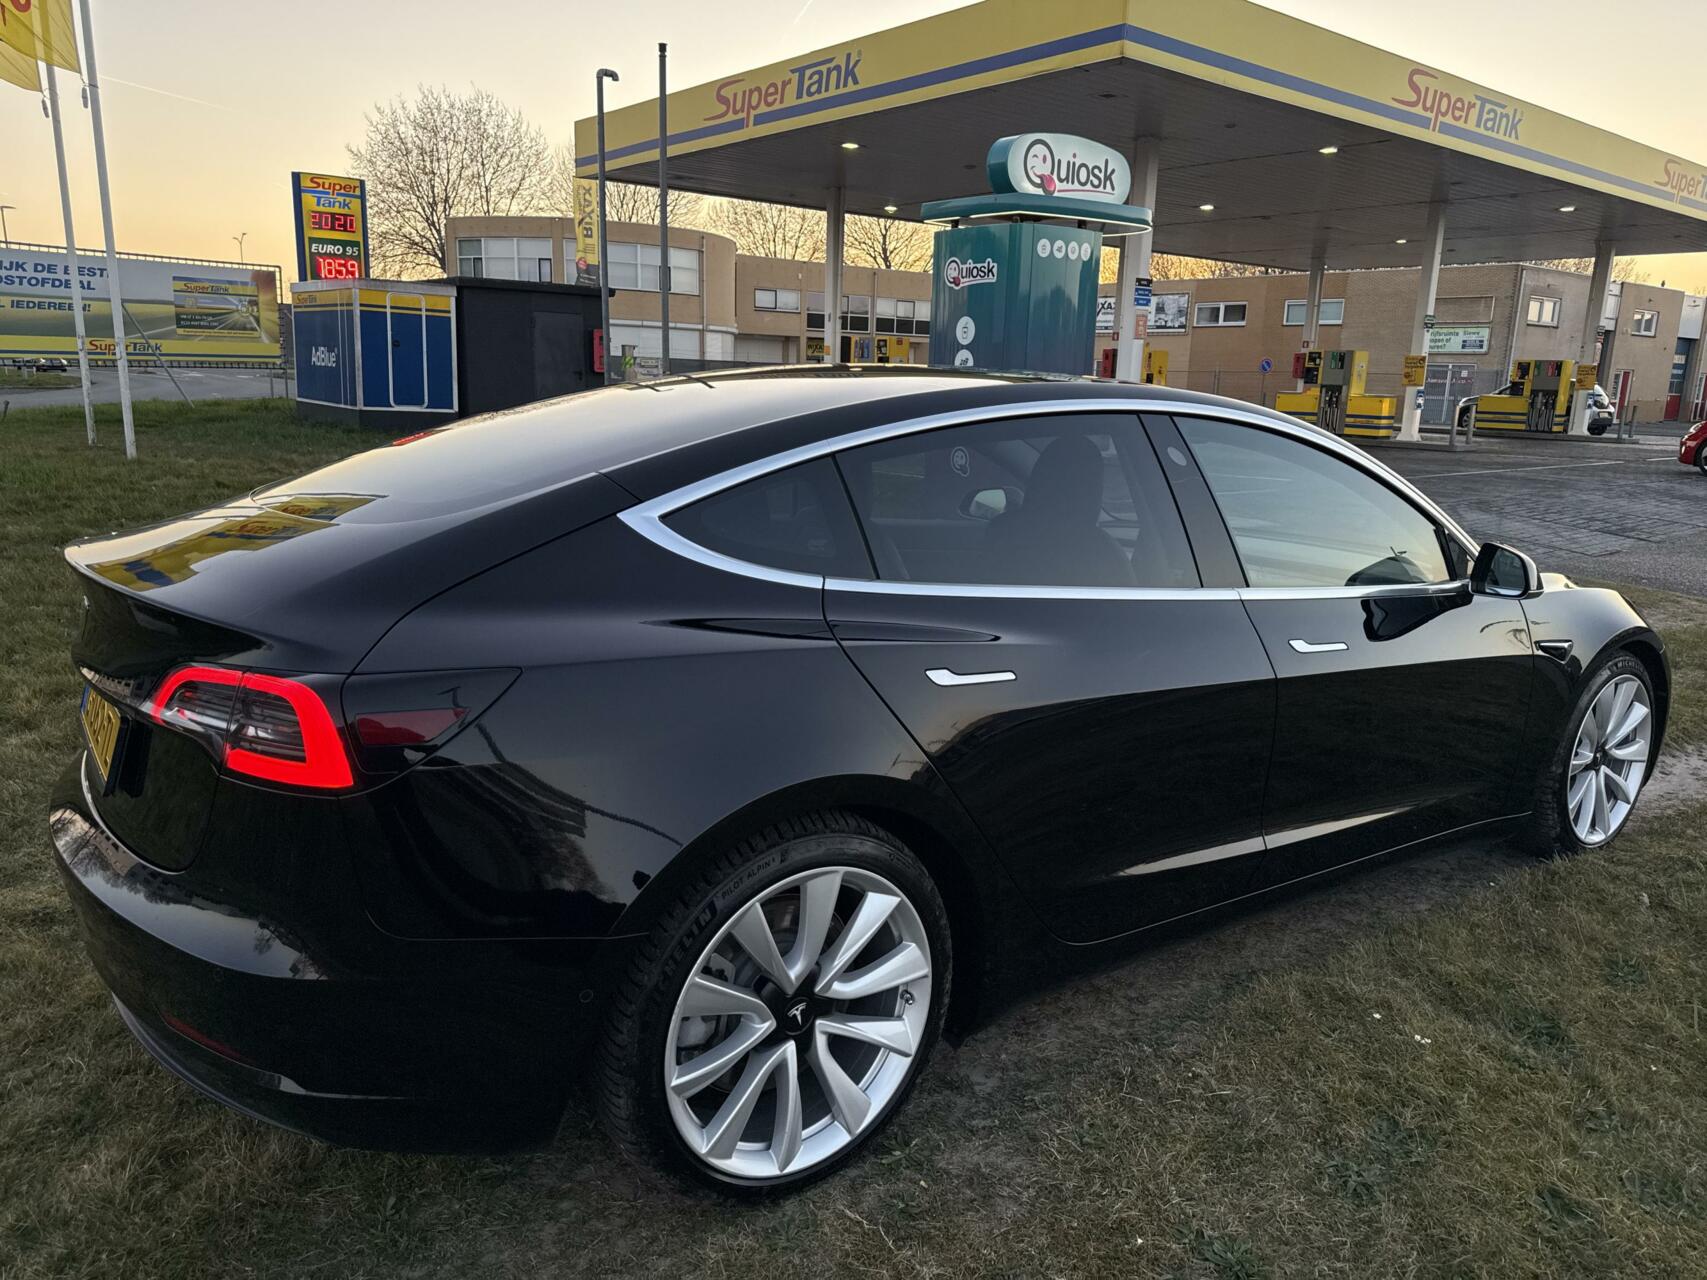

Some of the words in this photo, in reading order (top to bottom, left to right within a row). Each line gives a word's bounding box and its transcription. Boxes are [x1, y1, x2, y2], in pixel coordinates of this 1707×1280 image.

[703, 53, 862, 128] SuperTank
[1391, 68, 1523, 140] SuperTank
[1024, 139, 1115, 195] Quiosk
[303, 176, 359, 196] Super
[312, 195, 352, 210] Tank
[311, 243, 343, 254] EURO
[346, 246, 359, 256] 95
[33, 263, 58, 274] DE
[946, 260, 995, 287] Quiosk
[722, 878, 744, 899] PILOT
[747, 861, 771, 878] ALPIN
